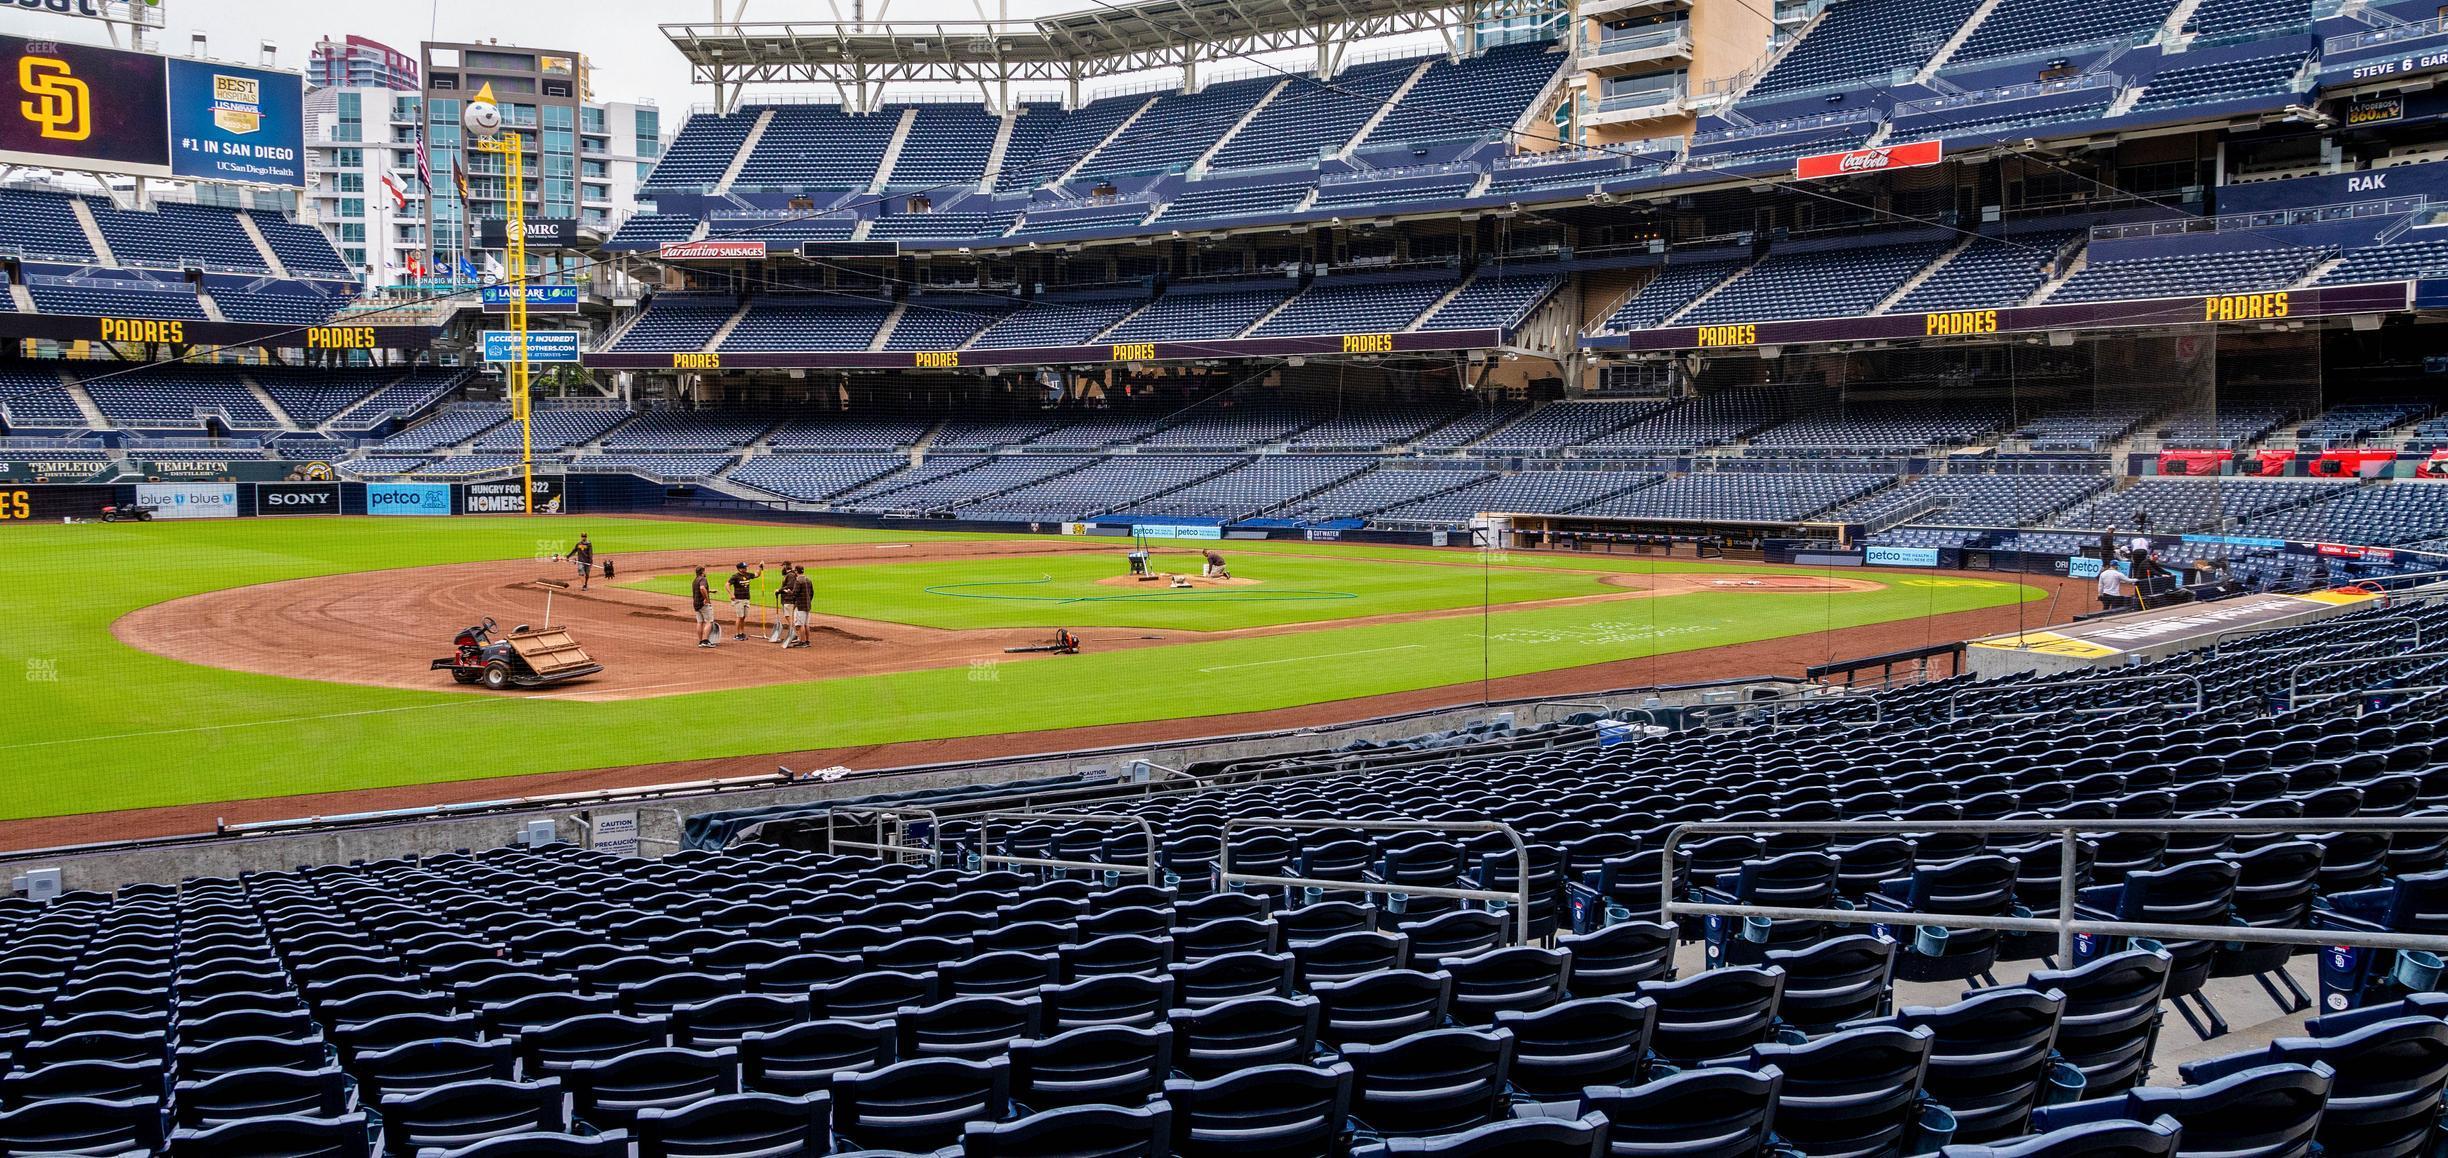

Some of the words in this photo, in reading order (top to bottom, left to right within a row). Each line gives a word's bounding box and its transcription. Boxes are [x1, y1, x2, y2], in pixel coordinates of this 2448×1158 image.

[2353, 62, 2395, 78] STEVE
[2402, 59, 2413, 71] 6
[217, 78, 256, 93] BEST
[217, 91, 256, 103] HOSPITALS
[182, 138, 199, 152] #1
[204, 140, 219, 154] IN
[223, 142, 251, 157] SAN
[255, 145, 294, 161] DIEGO
[216, 161, 231, 170] UC
[231, 163, 246, 173] San
[246, 164, 268, 176] Diego
[269, 166, 294, 177] Health
[2348, 174, 2387, 192] RAK
[527, 224, 559, 235] MRC
[663, 244, 719, 257] Tarantino
[720, 248, 763, 256] SAUSAGES
[547, 288, 576, 298] LOGIC
[2205, 292, 2289, 321] PADRES
[101, 317, 184, 343] PADRES
[1927, 310, 1998, 335] PADRES
[308, 327, 375, 348] PADRES
[536, 335, 575, 343] INJURED?
[1343, 334, 1393, 352] PADRES
[1698, 325, 1757, 347] PADRES
[1113, 343, 1155, 360] PADRES
[673, 353, 720, 368] PADRES
[916, 352, 958, 367] PADRES
[28, 462, 108, 473] TEMPLETON
[155, 461, 229, 473] TEMPLETON
[471, 484, 505, 494] HUNGRY
[505, 484, 521, 494] FOR
[531, 482, 549, 493] 322
[141, 494, 172, 505] blue
[190, 493, 220, 504] blue
[268, 493, 331, 505] SONY
[372, 490, 420, 505] petco
[468, 496, 526, 511] HOMERS
[1868, 549, 1901, 562] petco
[2071, 560, 2100, 574] petco
[600, 819, 633, 828] CAUTION
